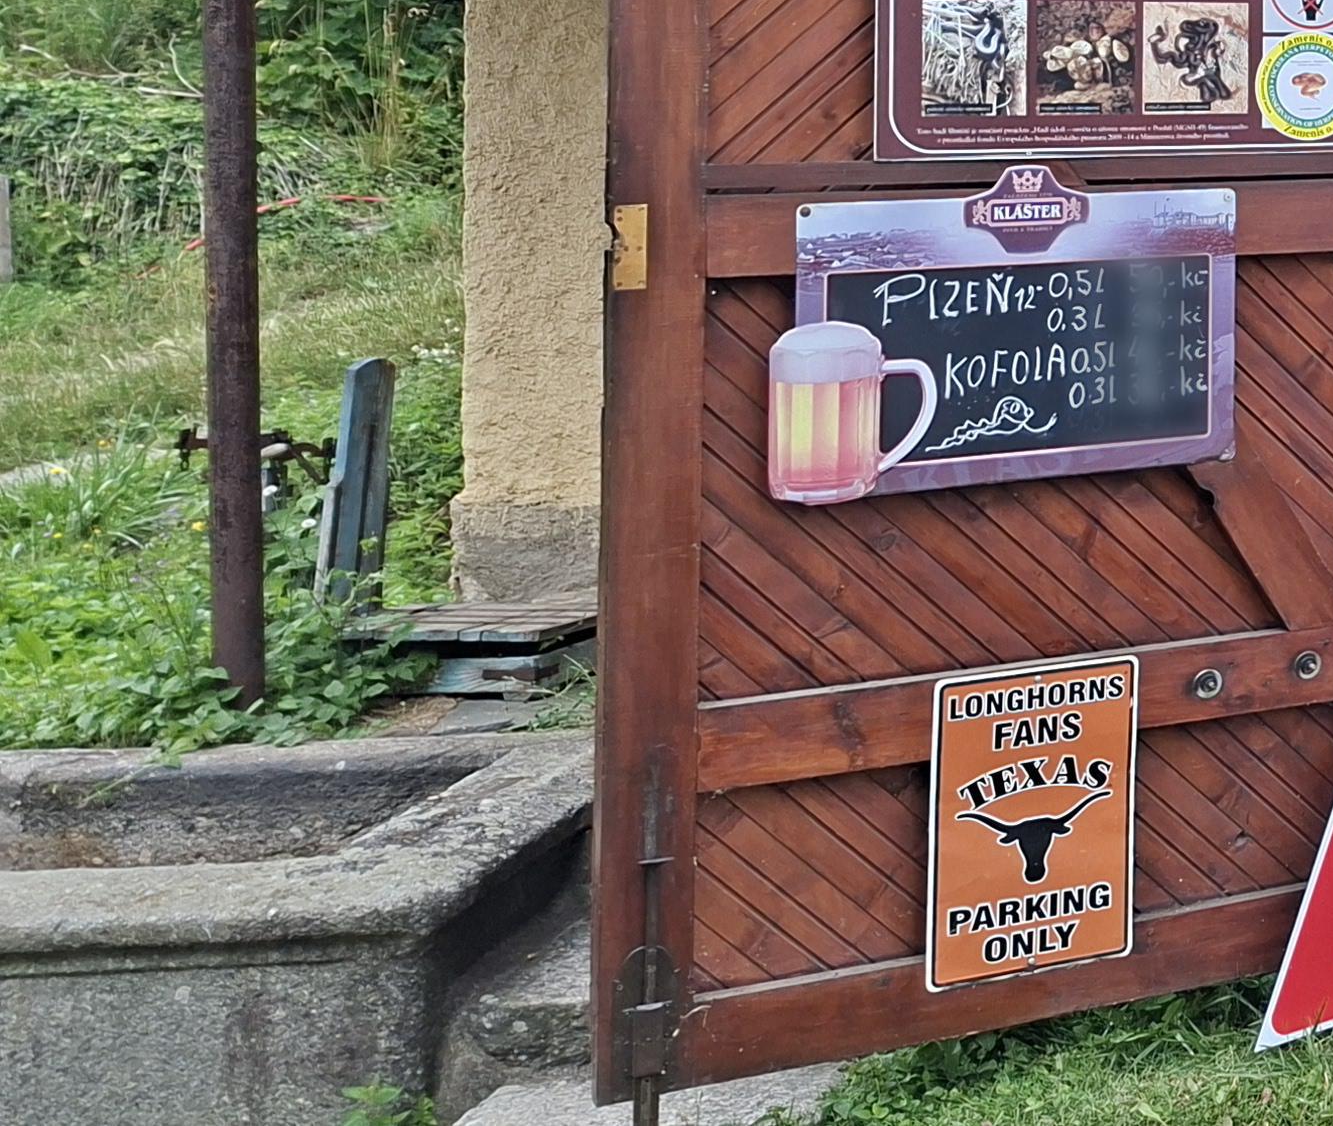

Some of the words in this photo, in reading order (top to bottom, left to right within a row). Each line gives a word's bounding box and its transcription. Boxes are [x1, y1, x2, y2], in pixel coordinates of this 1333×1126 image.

[993, 203, 1061, 220] KLÁŠTER
[944, 343, 1066, 399] KOFOLA
[948, 674, 1126, 721] LONGHORNS
[993, 711, 1083, 751] FANS
[958, 756, 1114, 811] TEXAS
[946, 881, 1113, 936] PARKING
[982, 920, 1080, 964] ONLY
